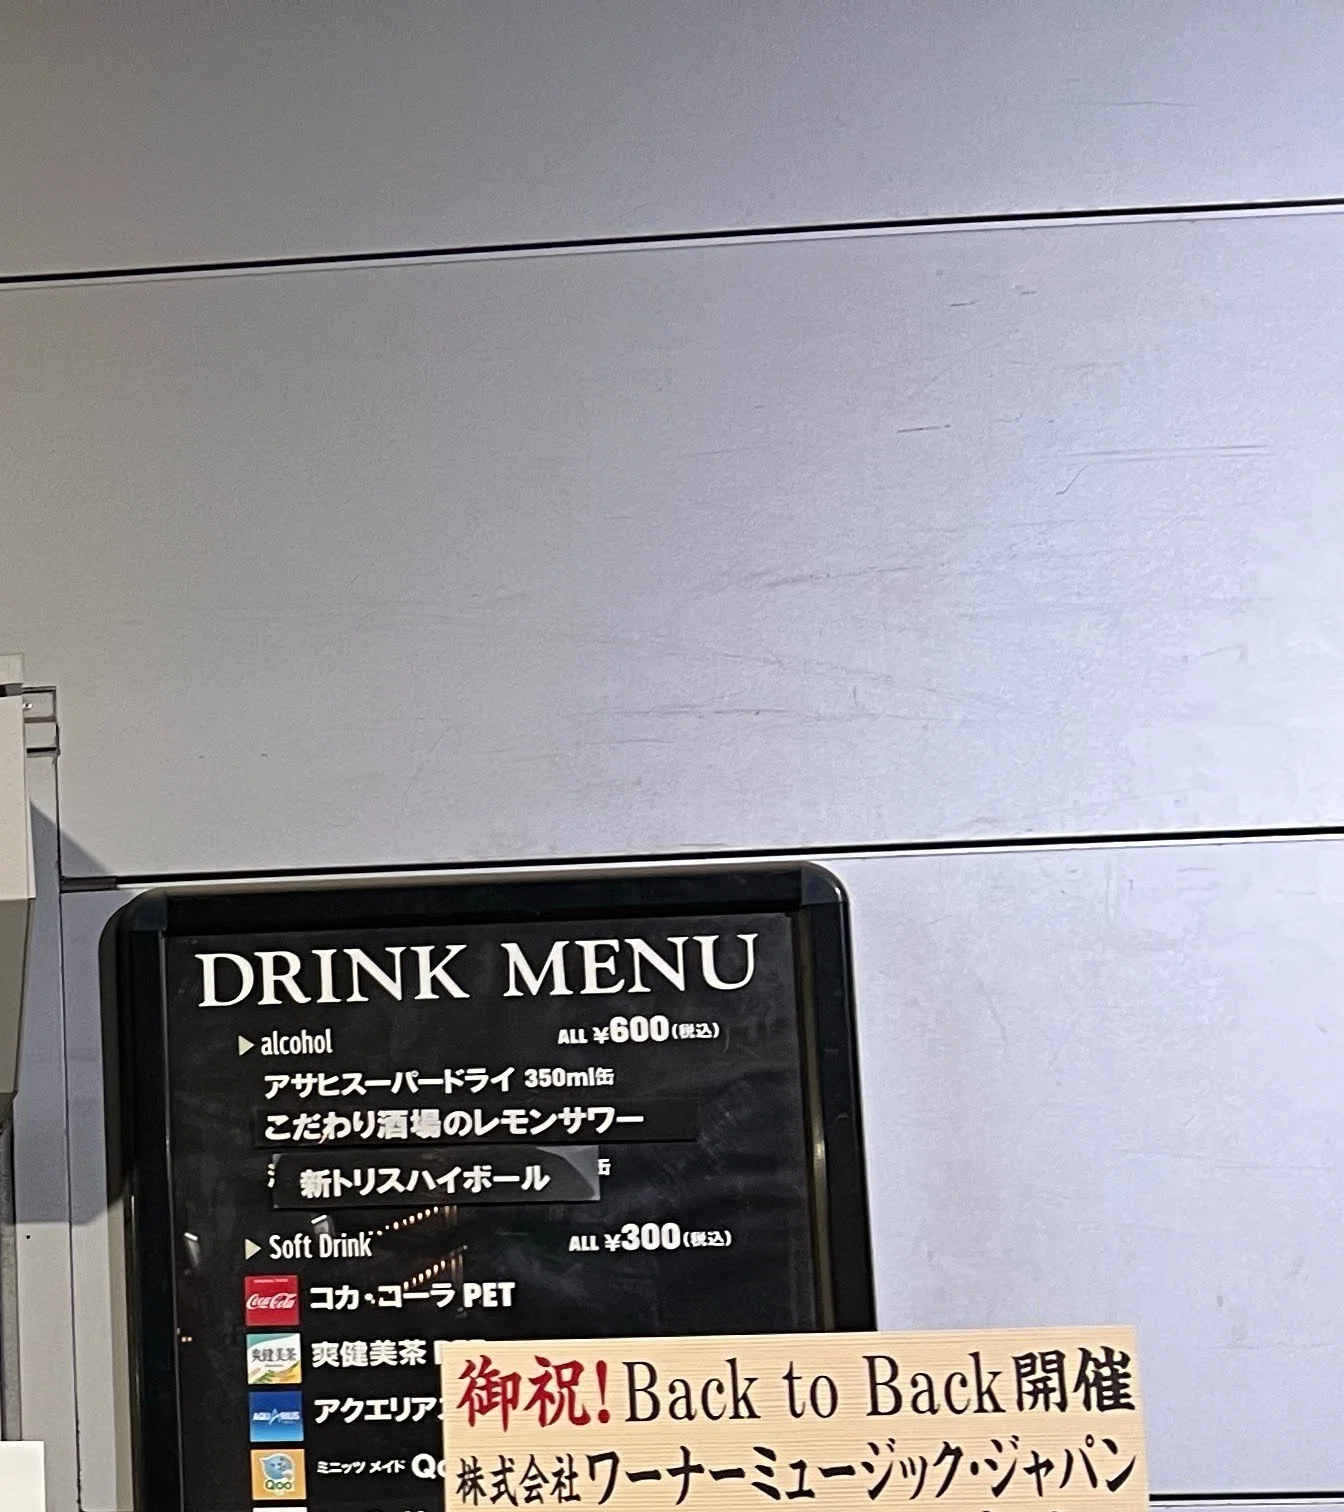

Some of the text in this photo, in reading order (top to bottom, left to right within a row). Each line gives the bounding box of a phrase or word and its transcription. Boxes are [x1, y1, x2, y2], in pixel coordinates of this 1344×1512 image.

[194, 930, 760, 1010] DRINK MENU
[260, 1027, 334, 1058] alcohol
[557, 1026, 589, 1046] ALL
[263, 1066, 616, 1101] アサヒスーパードライ 350ml缶
[263, 1104, 646, 1142] こだわり酒場のレモンサワー
[299, 1164, 551, 1200] 新トリスハイボール
[269, 1232, 373, 1260] Soft Drink
[568, 1235, 600, 1253] ALL
[309, 1282, 516, 1310] コカ・コーラ PET
[311, 1339, 427, 1368] 爽健美茶
[457, 1353, 610, 1432] 御祝!
[783, 1361, 839, 1419] to
[314, 1396, 445, 1424] アクエリア
[265, 1480, 292, 1490] Qoo
